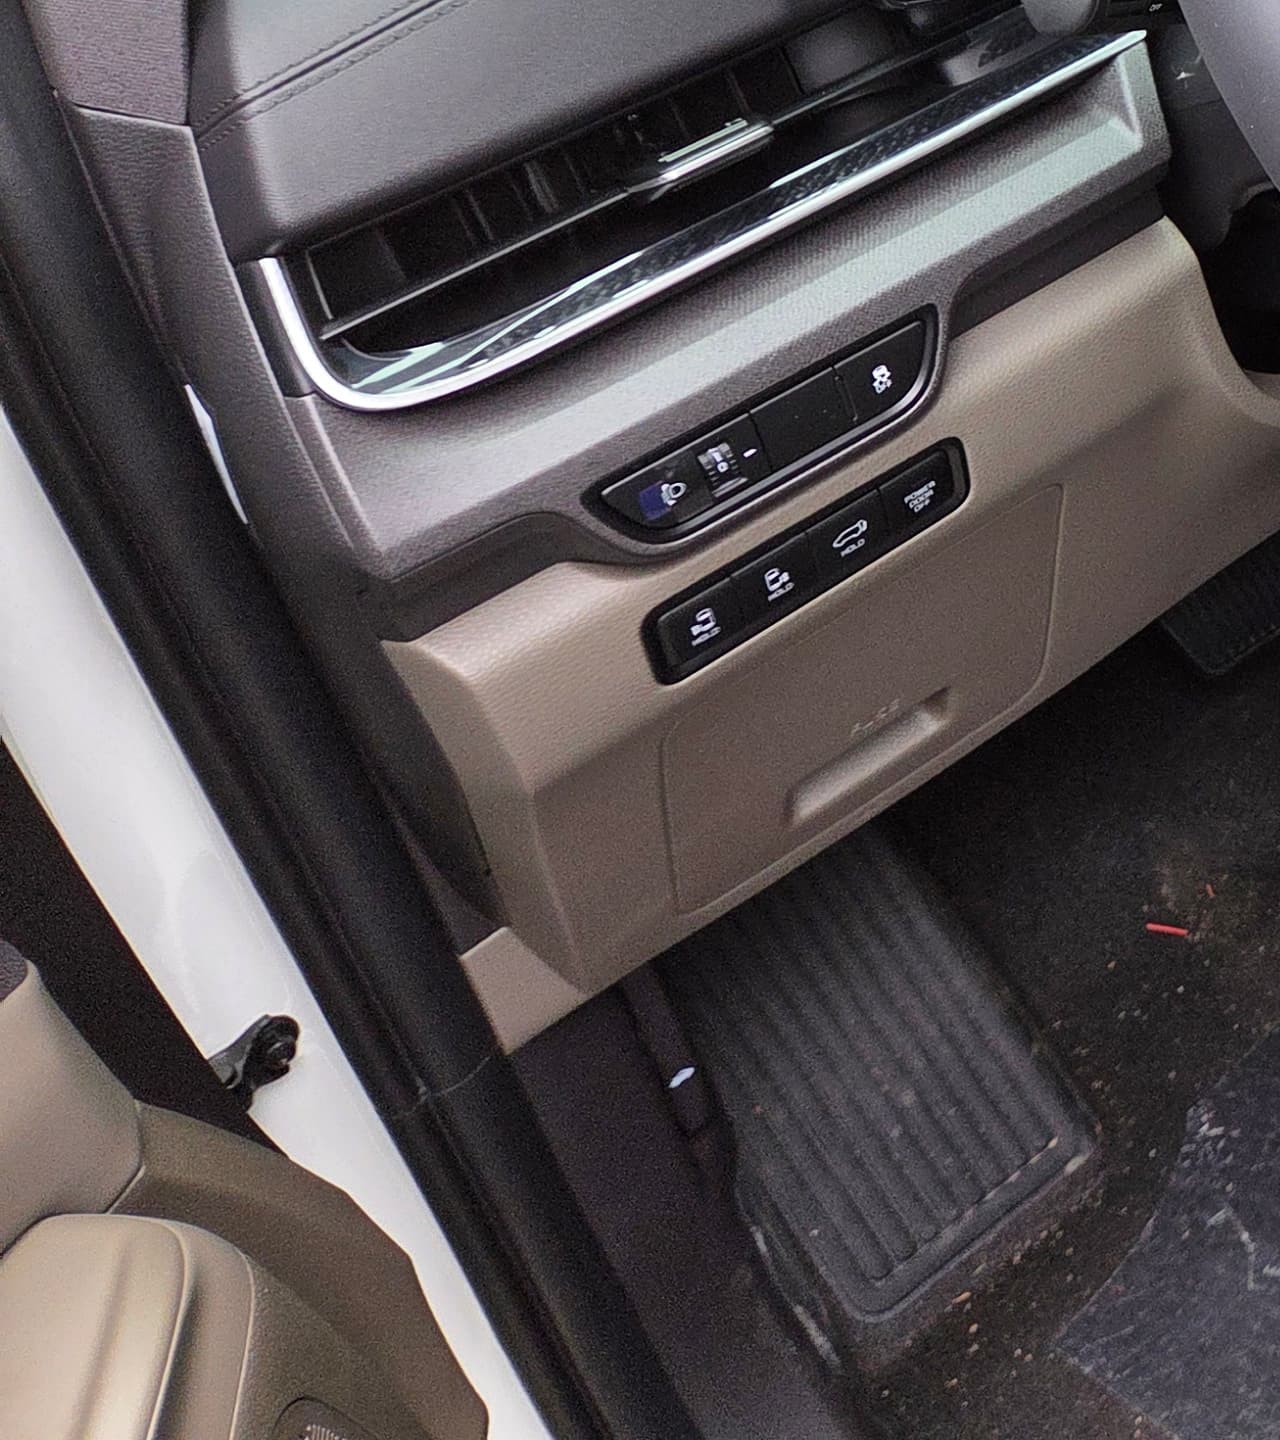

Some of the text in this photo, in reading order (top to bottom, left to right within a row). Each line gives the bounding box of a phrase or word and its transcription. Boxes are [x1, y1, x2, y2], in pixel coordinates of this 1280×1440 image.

[903, 480, 937, 505] POWER
[908, 488, 935, 509] DOOR
[913, 498, 931, 513] OFF
[840, 538, 866, 558] HOLD
[767, 582, 796, 603] HOLD
[691, 626, 722, 647] HOLD
